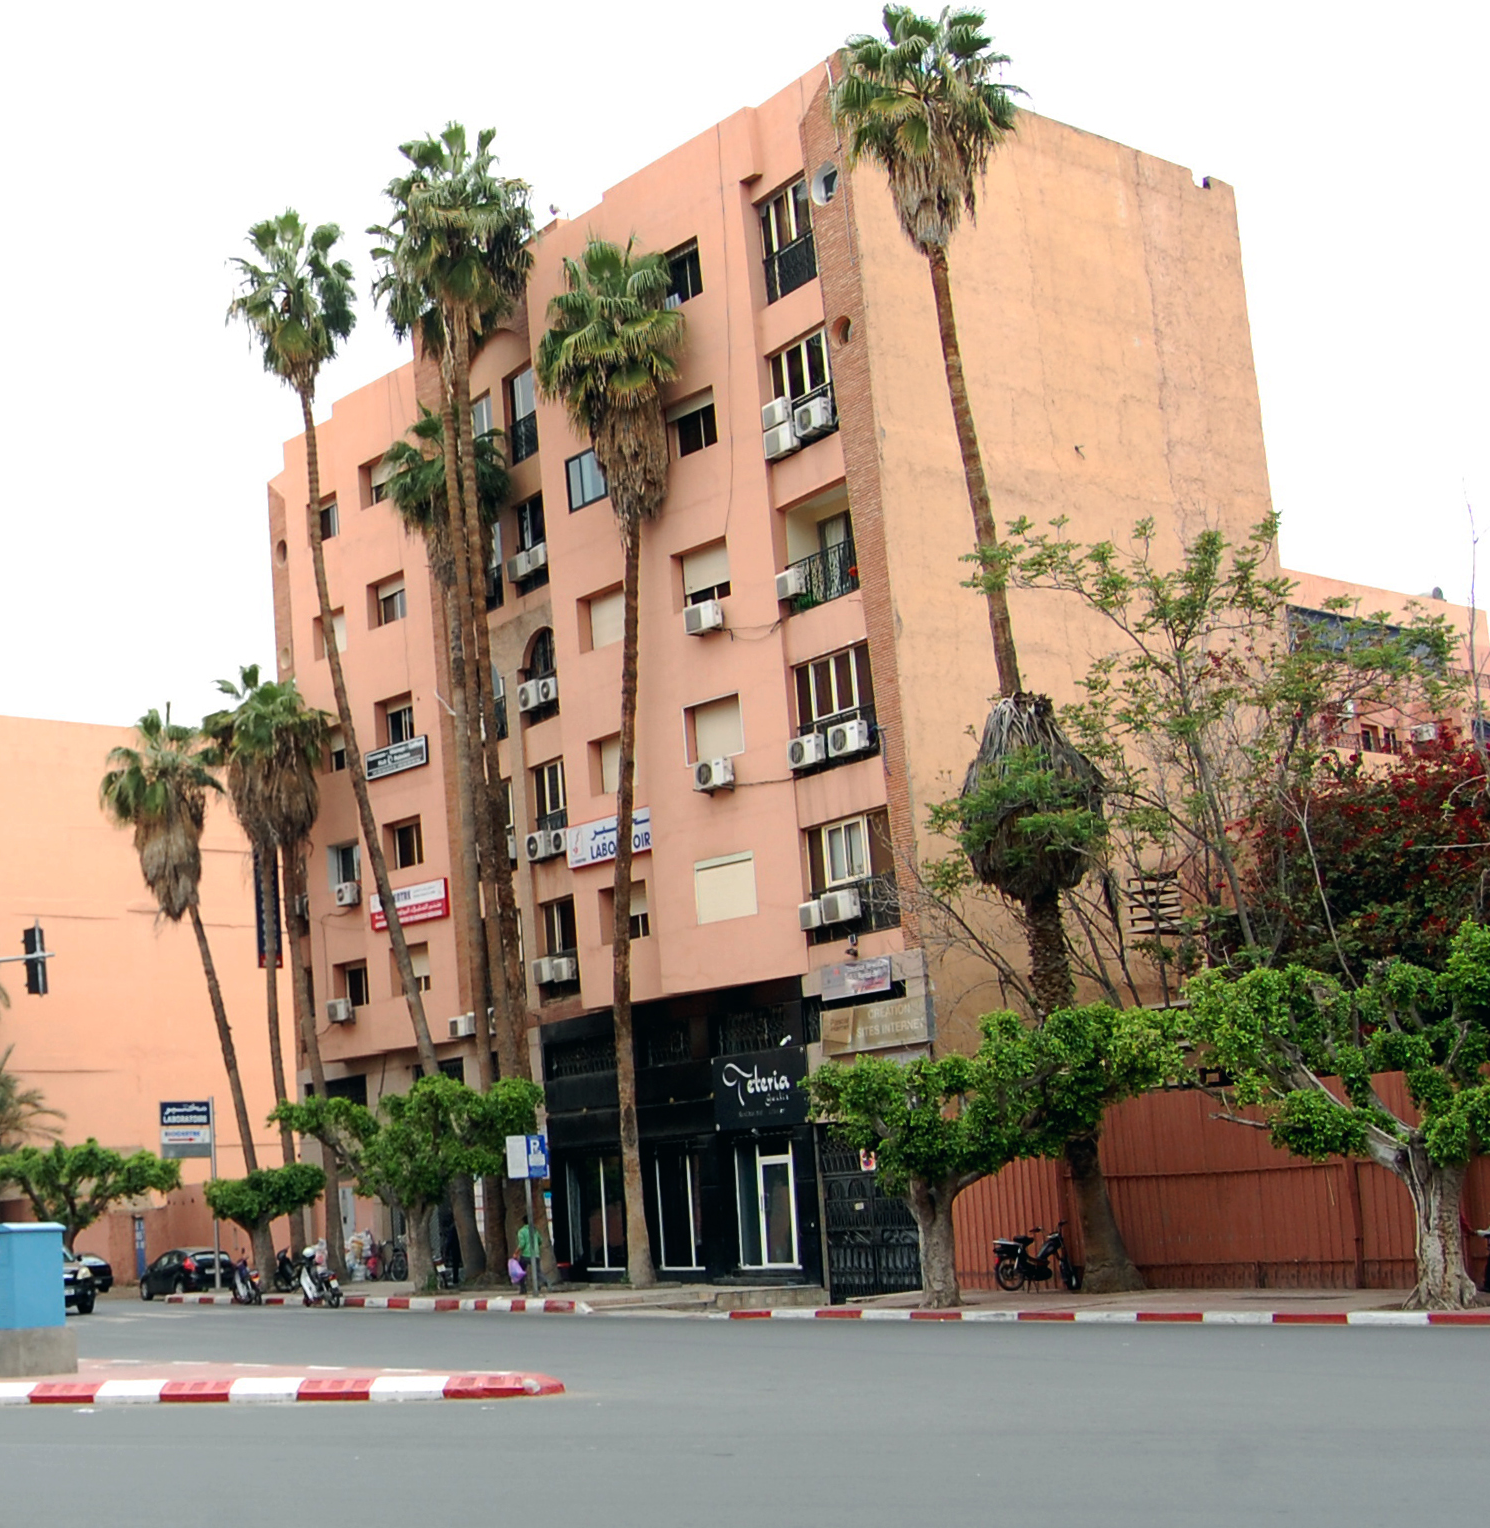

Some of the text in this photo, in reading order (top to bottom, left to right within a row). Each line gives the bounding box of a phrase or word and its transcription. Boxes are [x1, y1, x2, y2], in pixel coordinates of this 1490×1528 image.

[590, 831, 651, 860] LABOOIR
[866, 1003, 911, 1020] CREATION
[856, 1024, 881, 1038] SITES
[722, 1062, 791, 1107] Teteria
